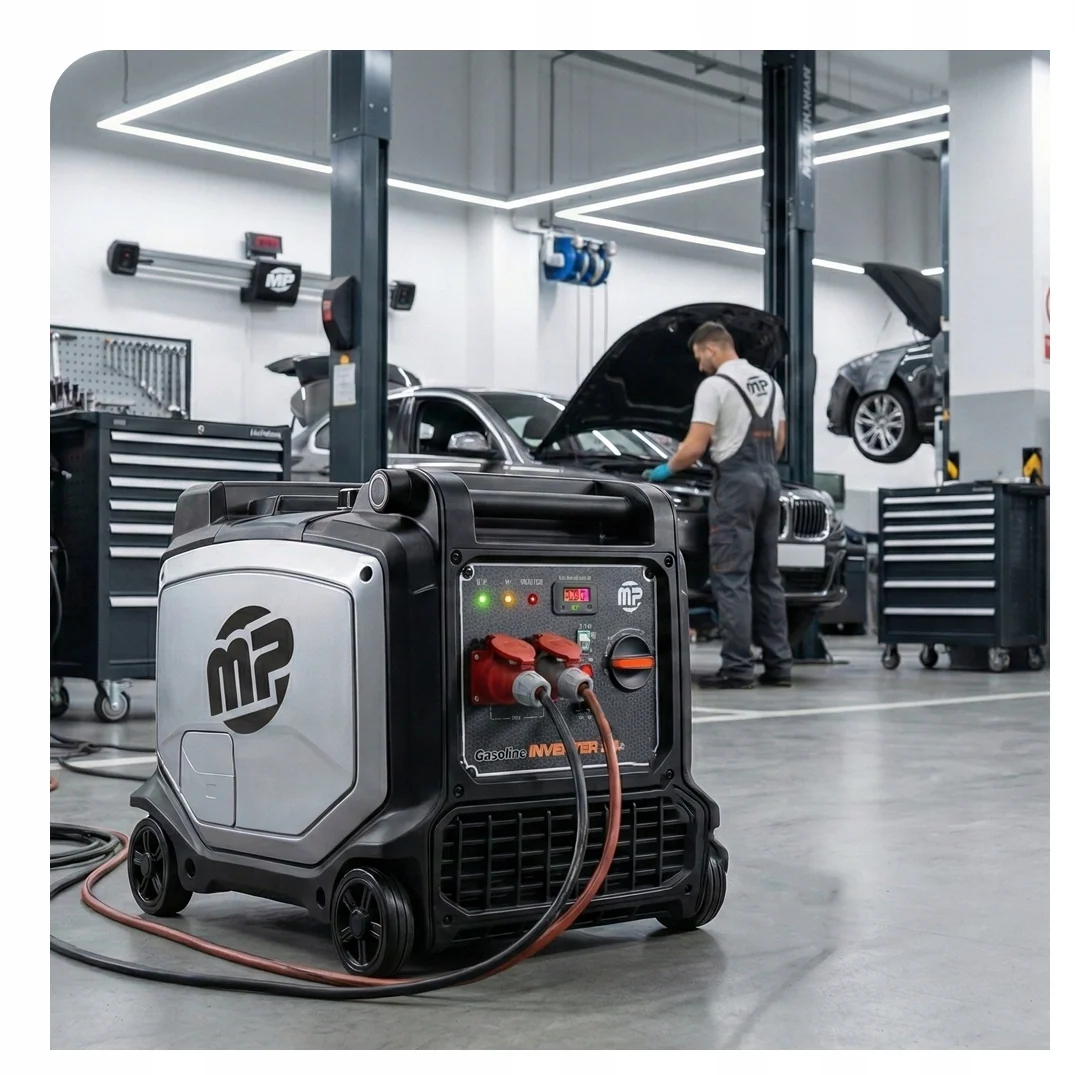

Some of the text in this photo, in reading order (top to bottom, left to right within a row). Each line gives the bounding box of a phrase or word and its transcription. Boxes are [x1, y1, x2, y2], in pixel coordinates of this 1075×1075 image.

[265, 269, 296, 291] MP
[618, 582, 643, 611] MP
[207, 610, 294, 728] MP
[474, 746, 528, 762] Gasoline
[528, 740, 598, 758] INVETER
